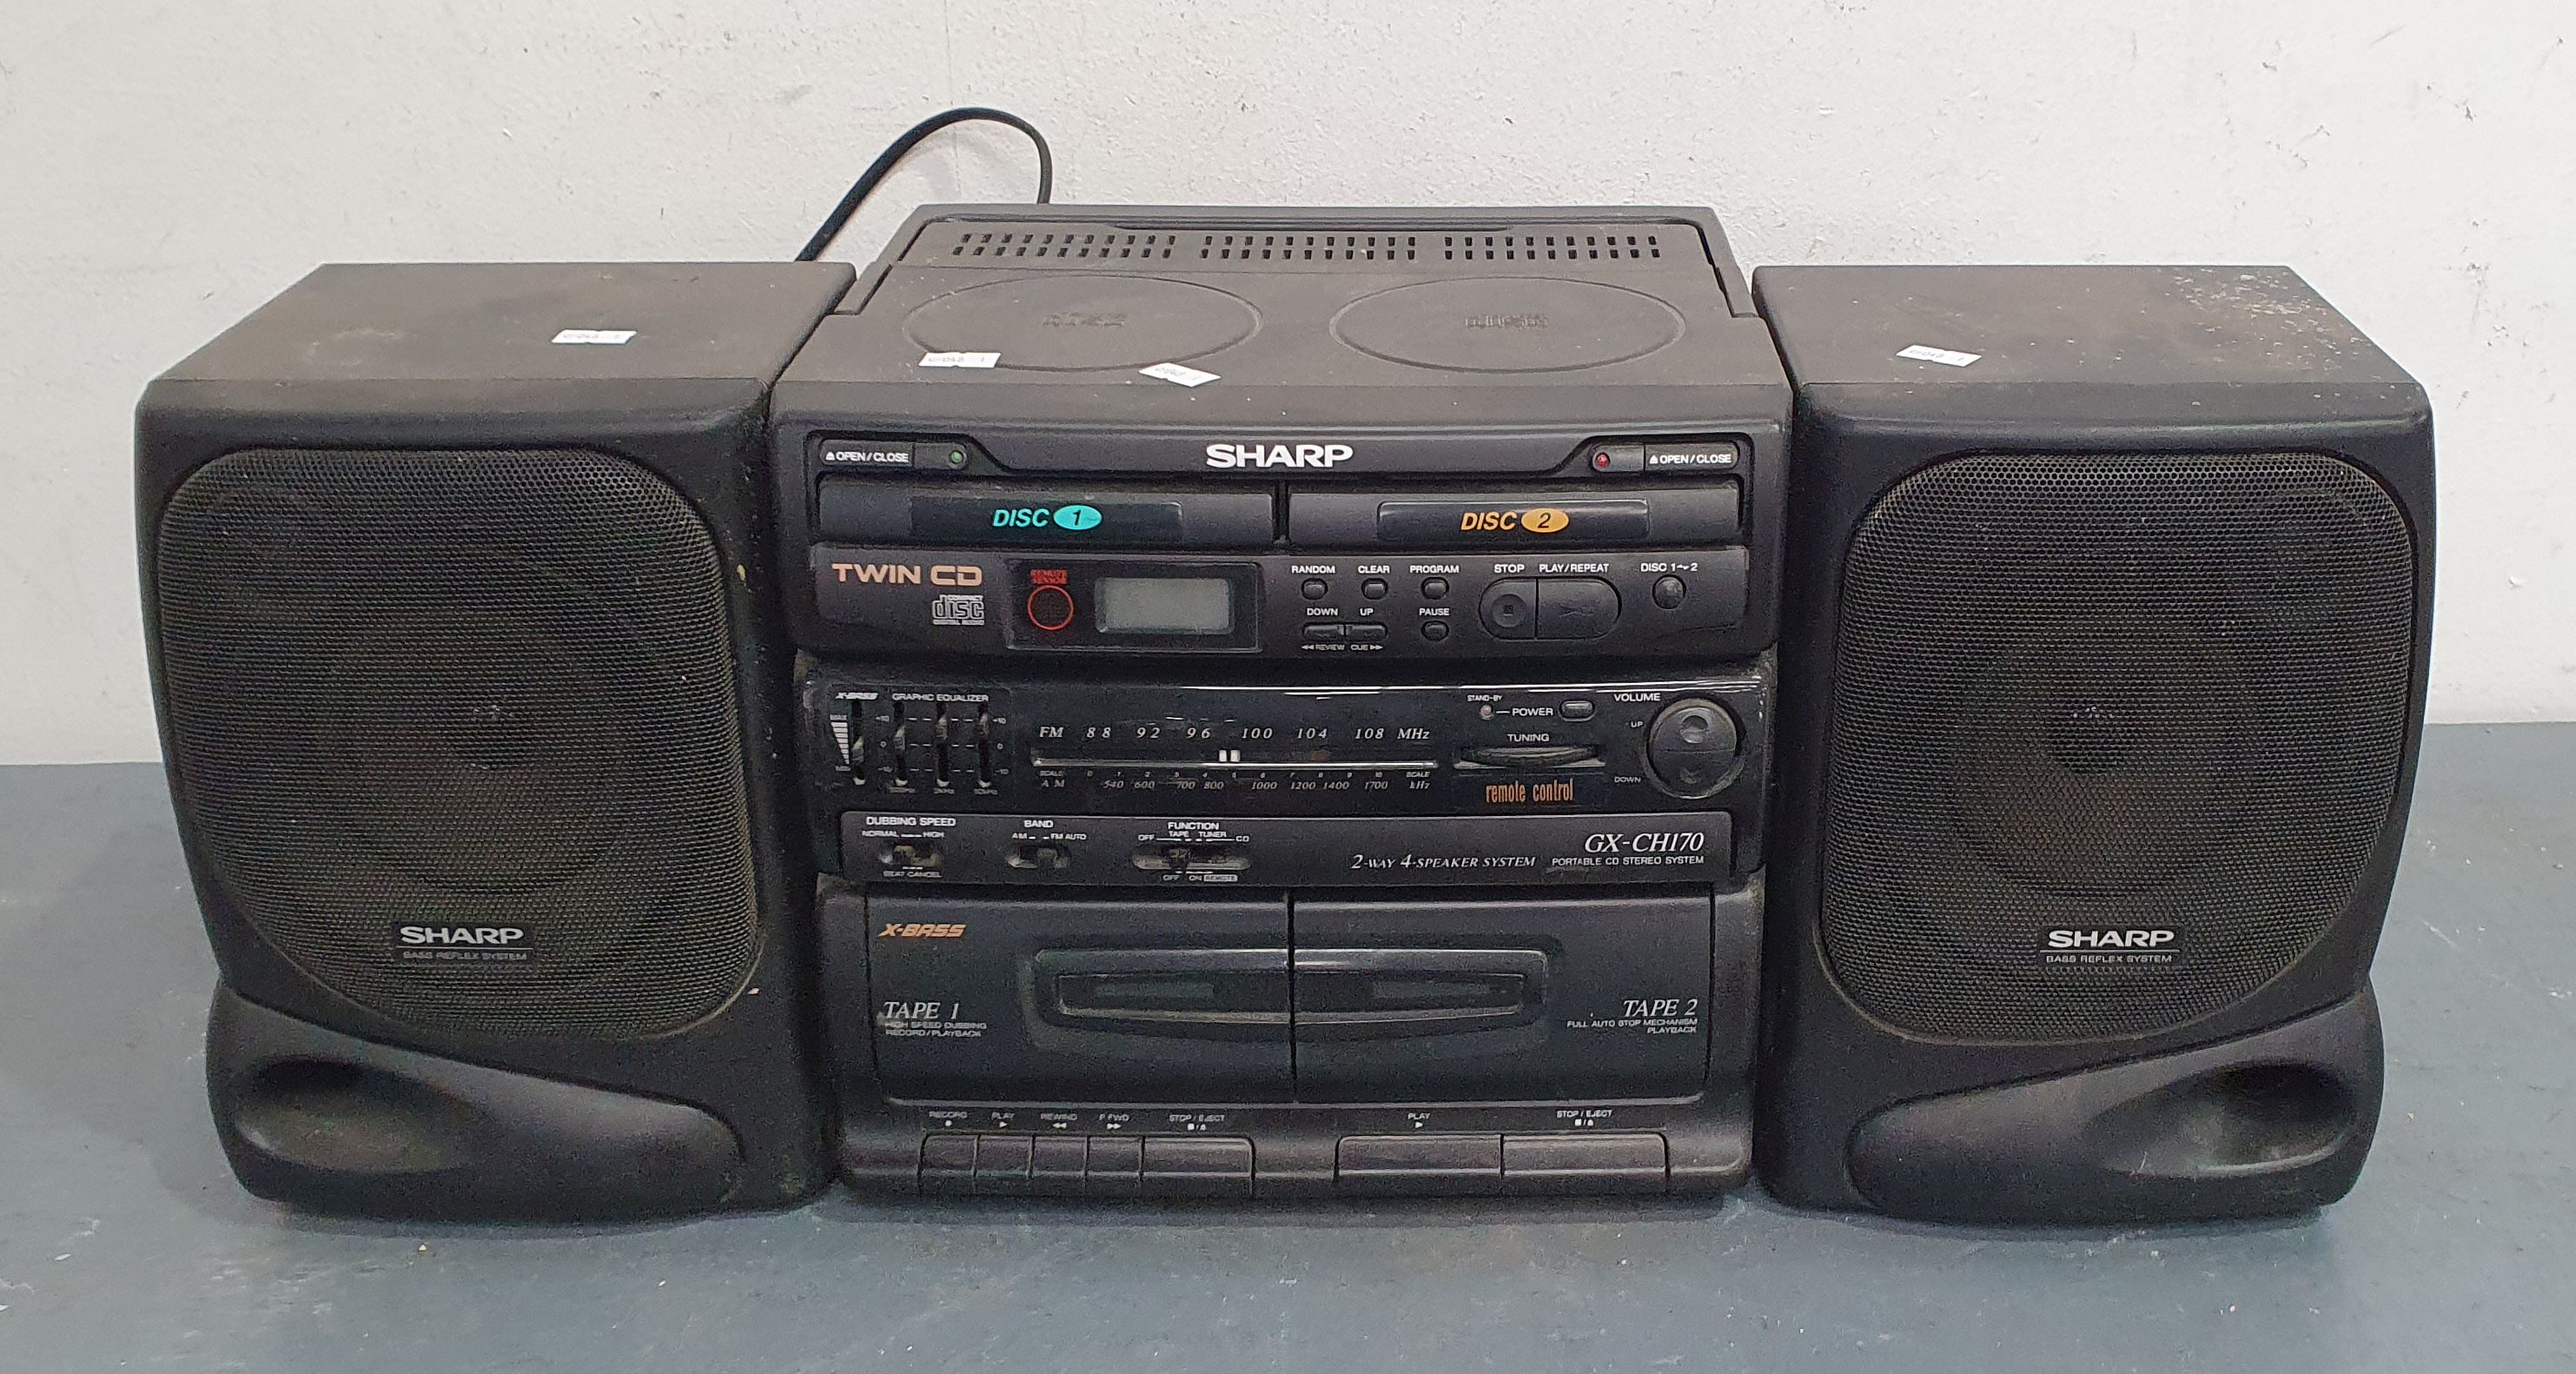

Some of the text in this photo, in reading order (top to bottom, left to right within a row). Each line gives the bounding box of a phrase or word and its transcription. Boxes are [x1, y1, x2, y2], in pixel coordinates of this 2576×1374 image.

[836, 451, 910, 463] OPEN/CLOSE
[1206, 443, 1354, 469] SHARP
[992, 508, 1083, 528] DISC 1
[1460, 510, 1552, 531] DISC 2
[1291, 565, 1460, 574] RANDOM CLEAR PROGRAM
[1493, 563, 1610, 574] STOP PLAY/REPEAT
[1640, 562, 1667, 573] DISC
[831, 563, 983, 587] TWIN CD
[1306, 607, 1451, 617] DOWN UP PAUSE
[1350, 643, 1370, 652] CUE
[892, 694, 990, 703] GRAPHIC EQUALIZER
[1613, 693, 1662, 703] VOLUME
[1512, 707, 1554, 717] POWER
[1039, 727, 1431, 740] FM 88 92 96 100 104 108 MHz
[1507, 733, 1551, 743] TUNING
[1614, 775, 1642, 784] DOWN
[1102, 780, 1125, 790] 540
[1134, 780, 1156, 790] 600
[1177, 780, 1197, 790] 700
[1251, 781, 1279, 791] 1000
[1290, 781, 1317, 791] 1200
[1322, 781, 1351, 791] 1400
[1364, 781, 1389, 791] 1700
[1486, 779, 1574, 803] remote control
[866, 817, 956, 827] DUBBING SPEED
[1023, 820, 1054, 829] BAND
[1168, 821, 1220, 831] FUNCTION
[862, 830, 899, 839] NORMAL
[1584, 832, 1705, 853] GX-CH170
[1350, 853, 1536, 870] 2-WAY 4-SPEAKER SYSTEM
[1551, 855, 1705, 866] PORTABLE CD STEREO SYSTEM
[400, 926, 524, 945] SHARP
[877, 922, 967, 938] X-BASS
[2048, 930, 2175, 948] SHARP
[884, 1001, 960, 1019] TAPE 1
[1623, 999, 1699, 1018] TAPE 2
[944, 1021, 988, 1030] DUBBING
[1618, 1019, 1641, 1028] STOP
[1643, 1018, 1699, 1026] MECHANISM
[1647, 1026, 1698, 1035] PLAYBACK
[928, 1110, 968, 1119] RECORD
[1040, 1112, 1078, 1121] REWIND
